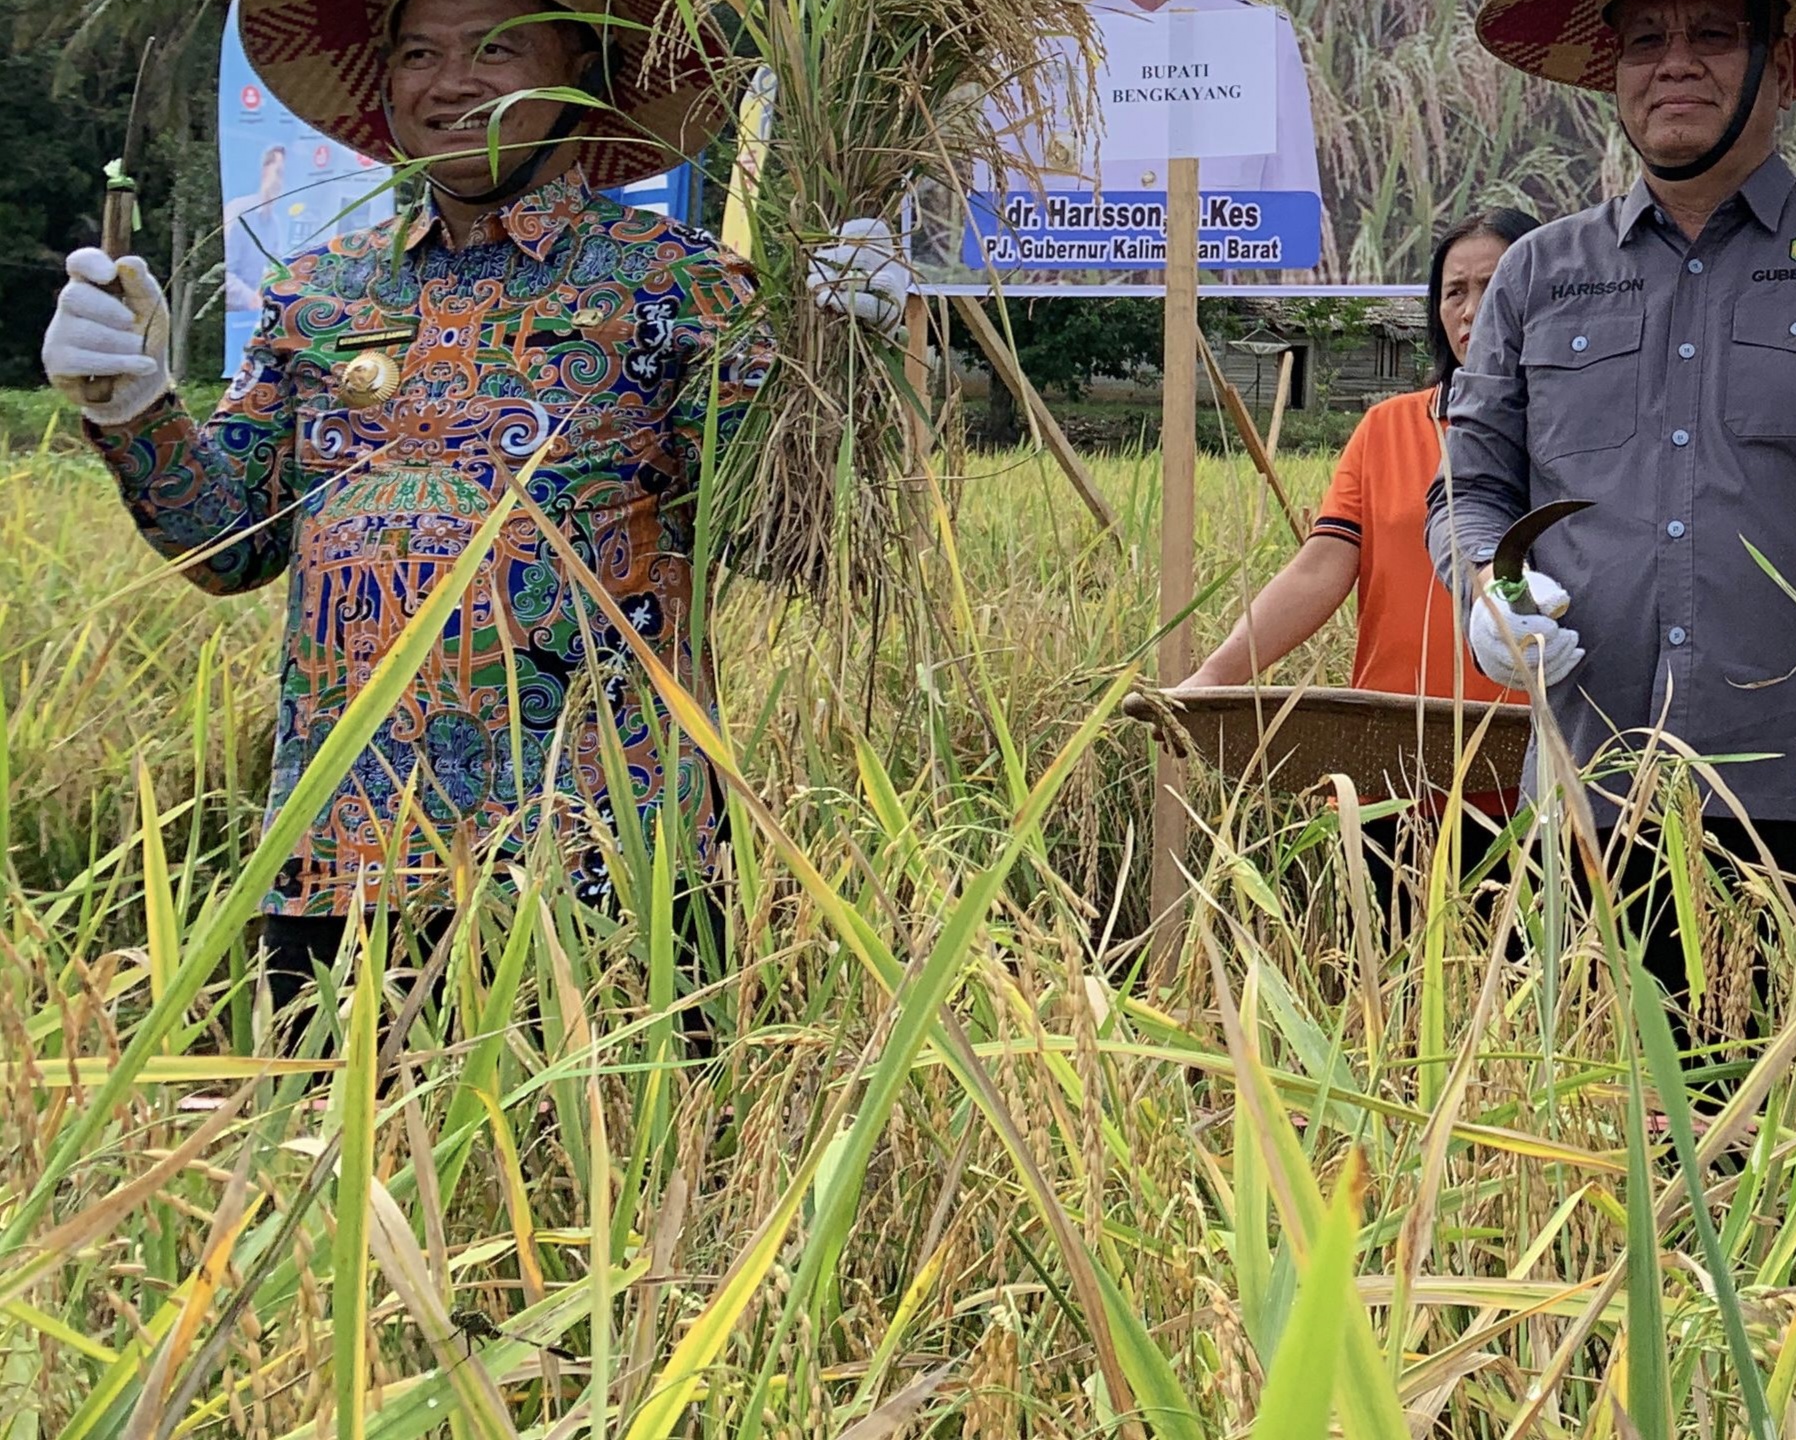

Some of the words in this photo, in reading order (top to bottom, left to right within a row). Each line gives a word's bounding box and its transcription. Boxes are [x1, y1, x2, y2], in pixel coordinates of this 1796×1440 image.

[1142, 64, 1208, 79] BUPATI
[1113, 85, 1241, 103] BENGKAYANG
[1021, 239, 1107, 259] Gubernur
[1228, 238, 1280, 259] Barat
[1551, 278, 1645, 300] HARISSON
